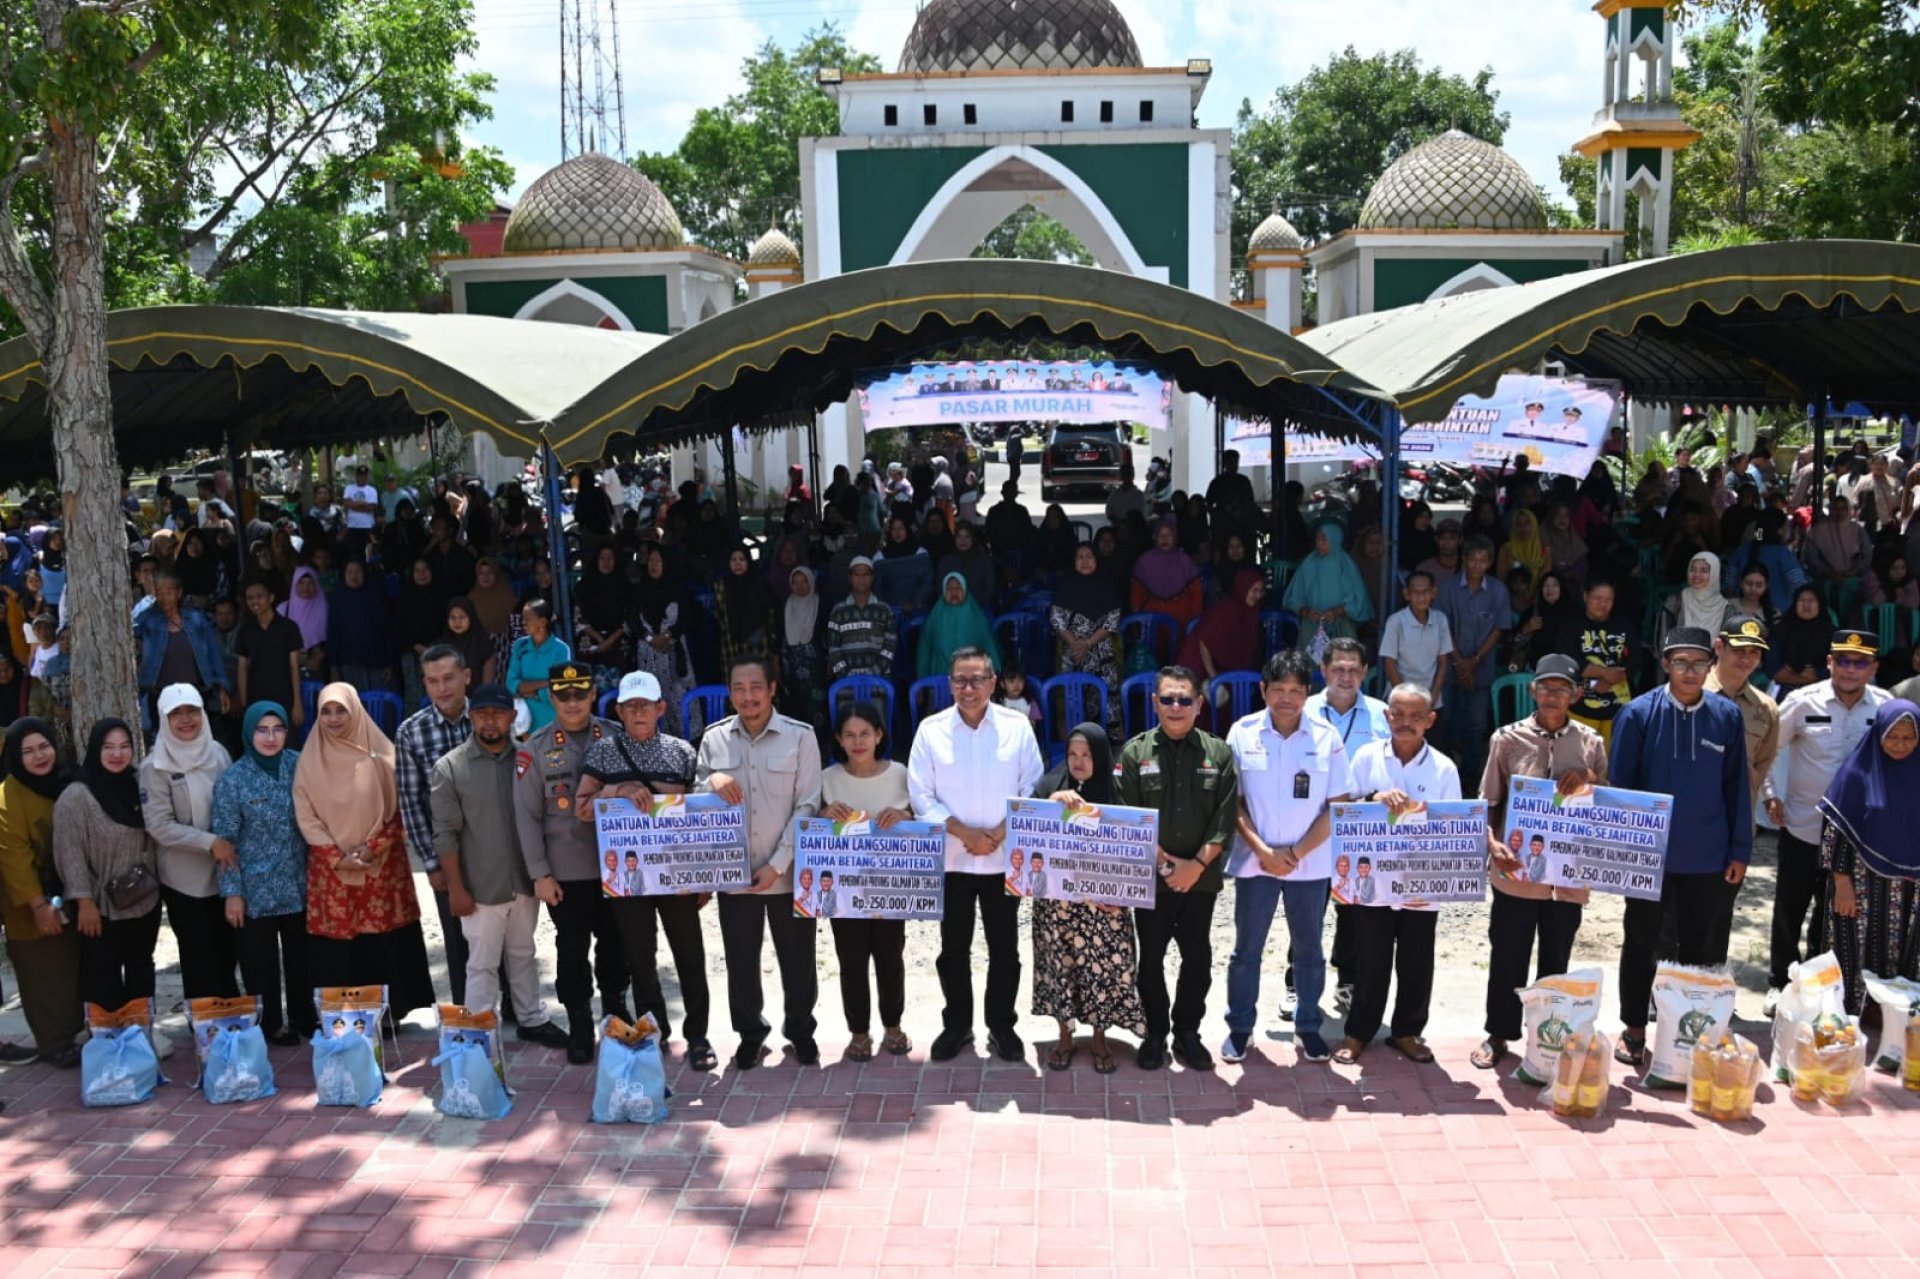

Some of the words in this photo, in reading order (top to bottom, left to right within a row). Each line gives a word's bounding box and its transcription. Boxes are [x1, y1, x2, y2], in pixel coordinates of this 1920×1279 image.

[940, 400, 1008, 416] PASAR
[1013, 398, 1090, 414] MURAH
[1447, 408, 1500, 422] NTUAN
[601, 816, 650, 831] BANTUAN
[652, 816, 708, 829] LANGSUNG
[710, 812, 740, 826] TUNAI
[1513, 797, 1564, 816] BANTUAN
[1568, 807, 1626, 824] LANGSUNG
[1630, 812, 1664, 829] TUNAI
[1012, 817, 1060, 834] BANTUAN
[1063, 822, 1117, 840] LANGSUNG
[1122, 827, 1152, 842] TUNAI
[1337, 822, 1386, 836] BANTUAN
[1390, 821, 1446, 835] LANGSUNG
[1450, 821, 1482, 834] TUNAI
[1518, 817, 1548, 830] HUMA
[1552, 822, 1592, 836] BETANG
[1595, 828, 1654, 845] SEJAHTERA
[610, 835, 638, 847] HUMA
[642, 833, 678, 846] BETANG
[681, 831, 735, 843] SEJAHTERA
[800, 837, 848, 850] BANTUAN
[852, 840, 906, 852] LANGSUNG
[910, 840, 941, 853] TUNAI
[1018, 836, 1045, 847] HUMA
[1050, 839, 1087, 851] BETANG
[1090, 842, 1144, 857] SEJAHTERA
[1343, 841, 1373, 852] HUMA
[1376, 840, 1415, 852] BETANG
[1418, 840, 1475, 851] SEJAHTERA
[807, 856, 835, 866] HUMA
[839, 857, 876, 867] BETANG
[879, 858, 933, 869] SEJAHTERA
[660, 873, 674, 886] Rp.
[678, 870, 713, 884] 250.000
[722, 868, 742, 882] KPM
[1562, 865, 1578, 878] Rp.
[1581, 866, 1621, 883] 250.000
[1631, 873, 1652, 888] KPM
[1063, 880, 1077, 894] Rp.
[1080, 881, 1116, 895] 250.000
[1127, 885, 1146, 898] KPM
[1392, 881, 1406, 894] Rp.
[1410, 880, 1447, 893] 250.000
[1458, 880, 1478, 893] KPM
[852, 896, 866, 910] Rp.
[870, 897, 906, 909] 250.000
[916, 899, 936, 910] KPM
